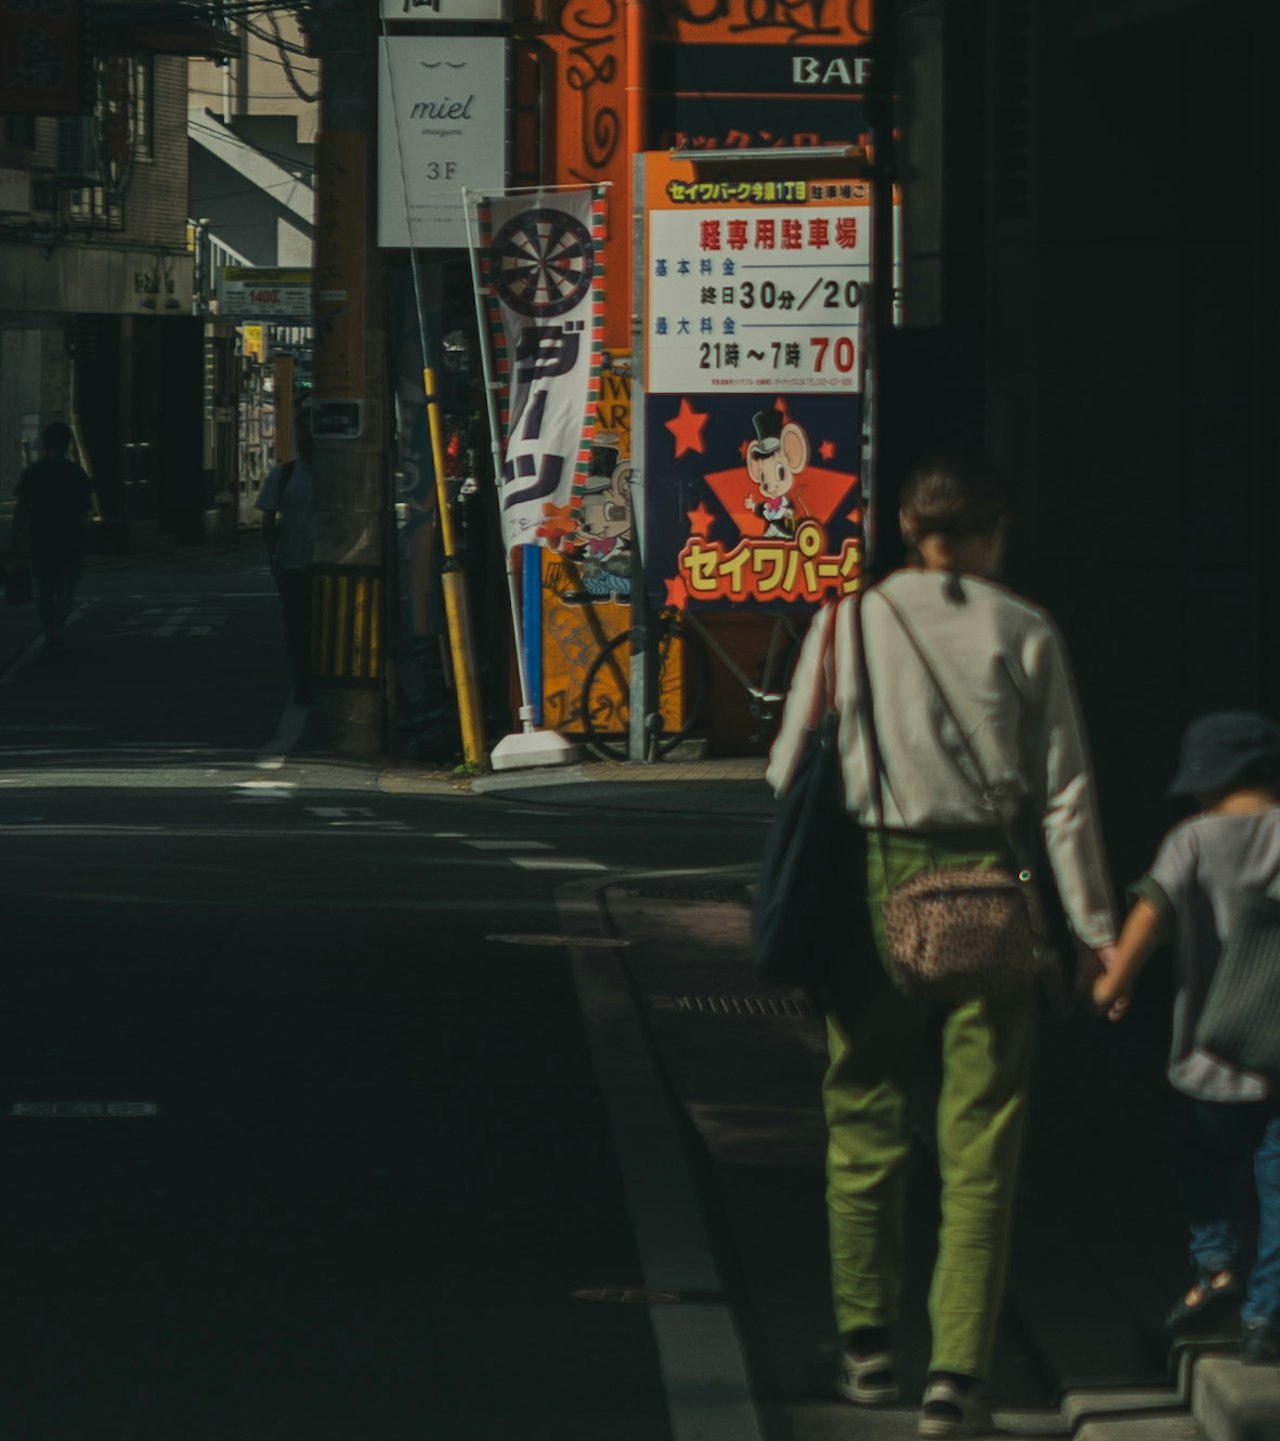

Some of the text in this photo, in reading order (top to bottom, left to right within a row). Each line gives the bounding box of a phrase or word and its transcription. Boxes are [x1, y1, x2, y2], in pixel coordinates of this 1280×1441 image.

[410, 93, 474, 120] miel
[700, 217, 858, 250] 軽専用駐車場
[655, 258, 735, 276] 基本料金
[655, 316, 735, 335] 最大料金
